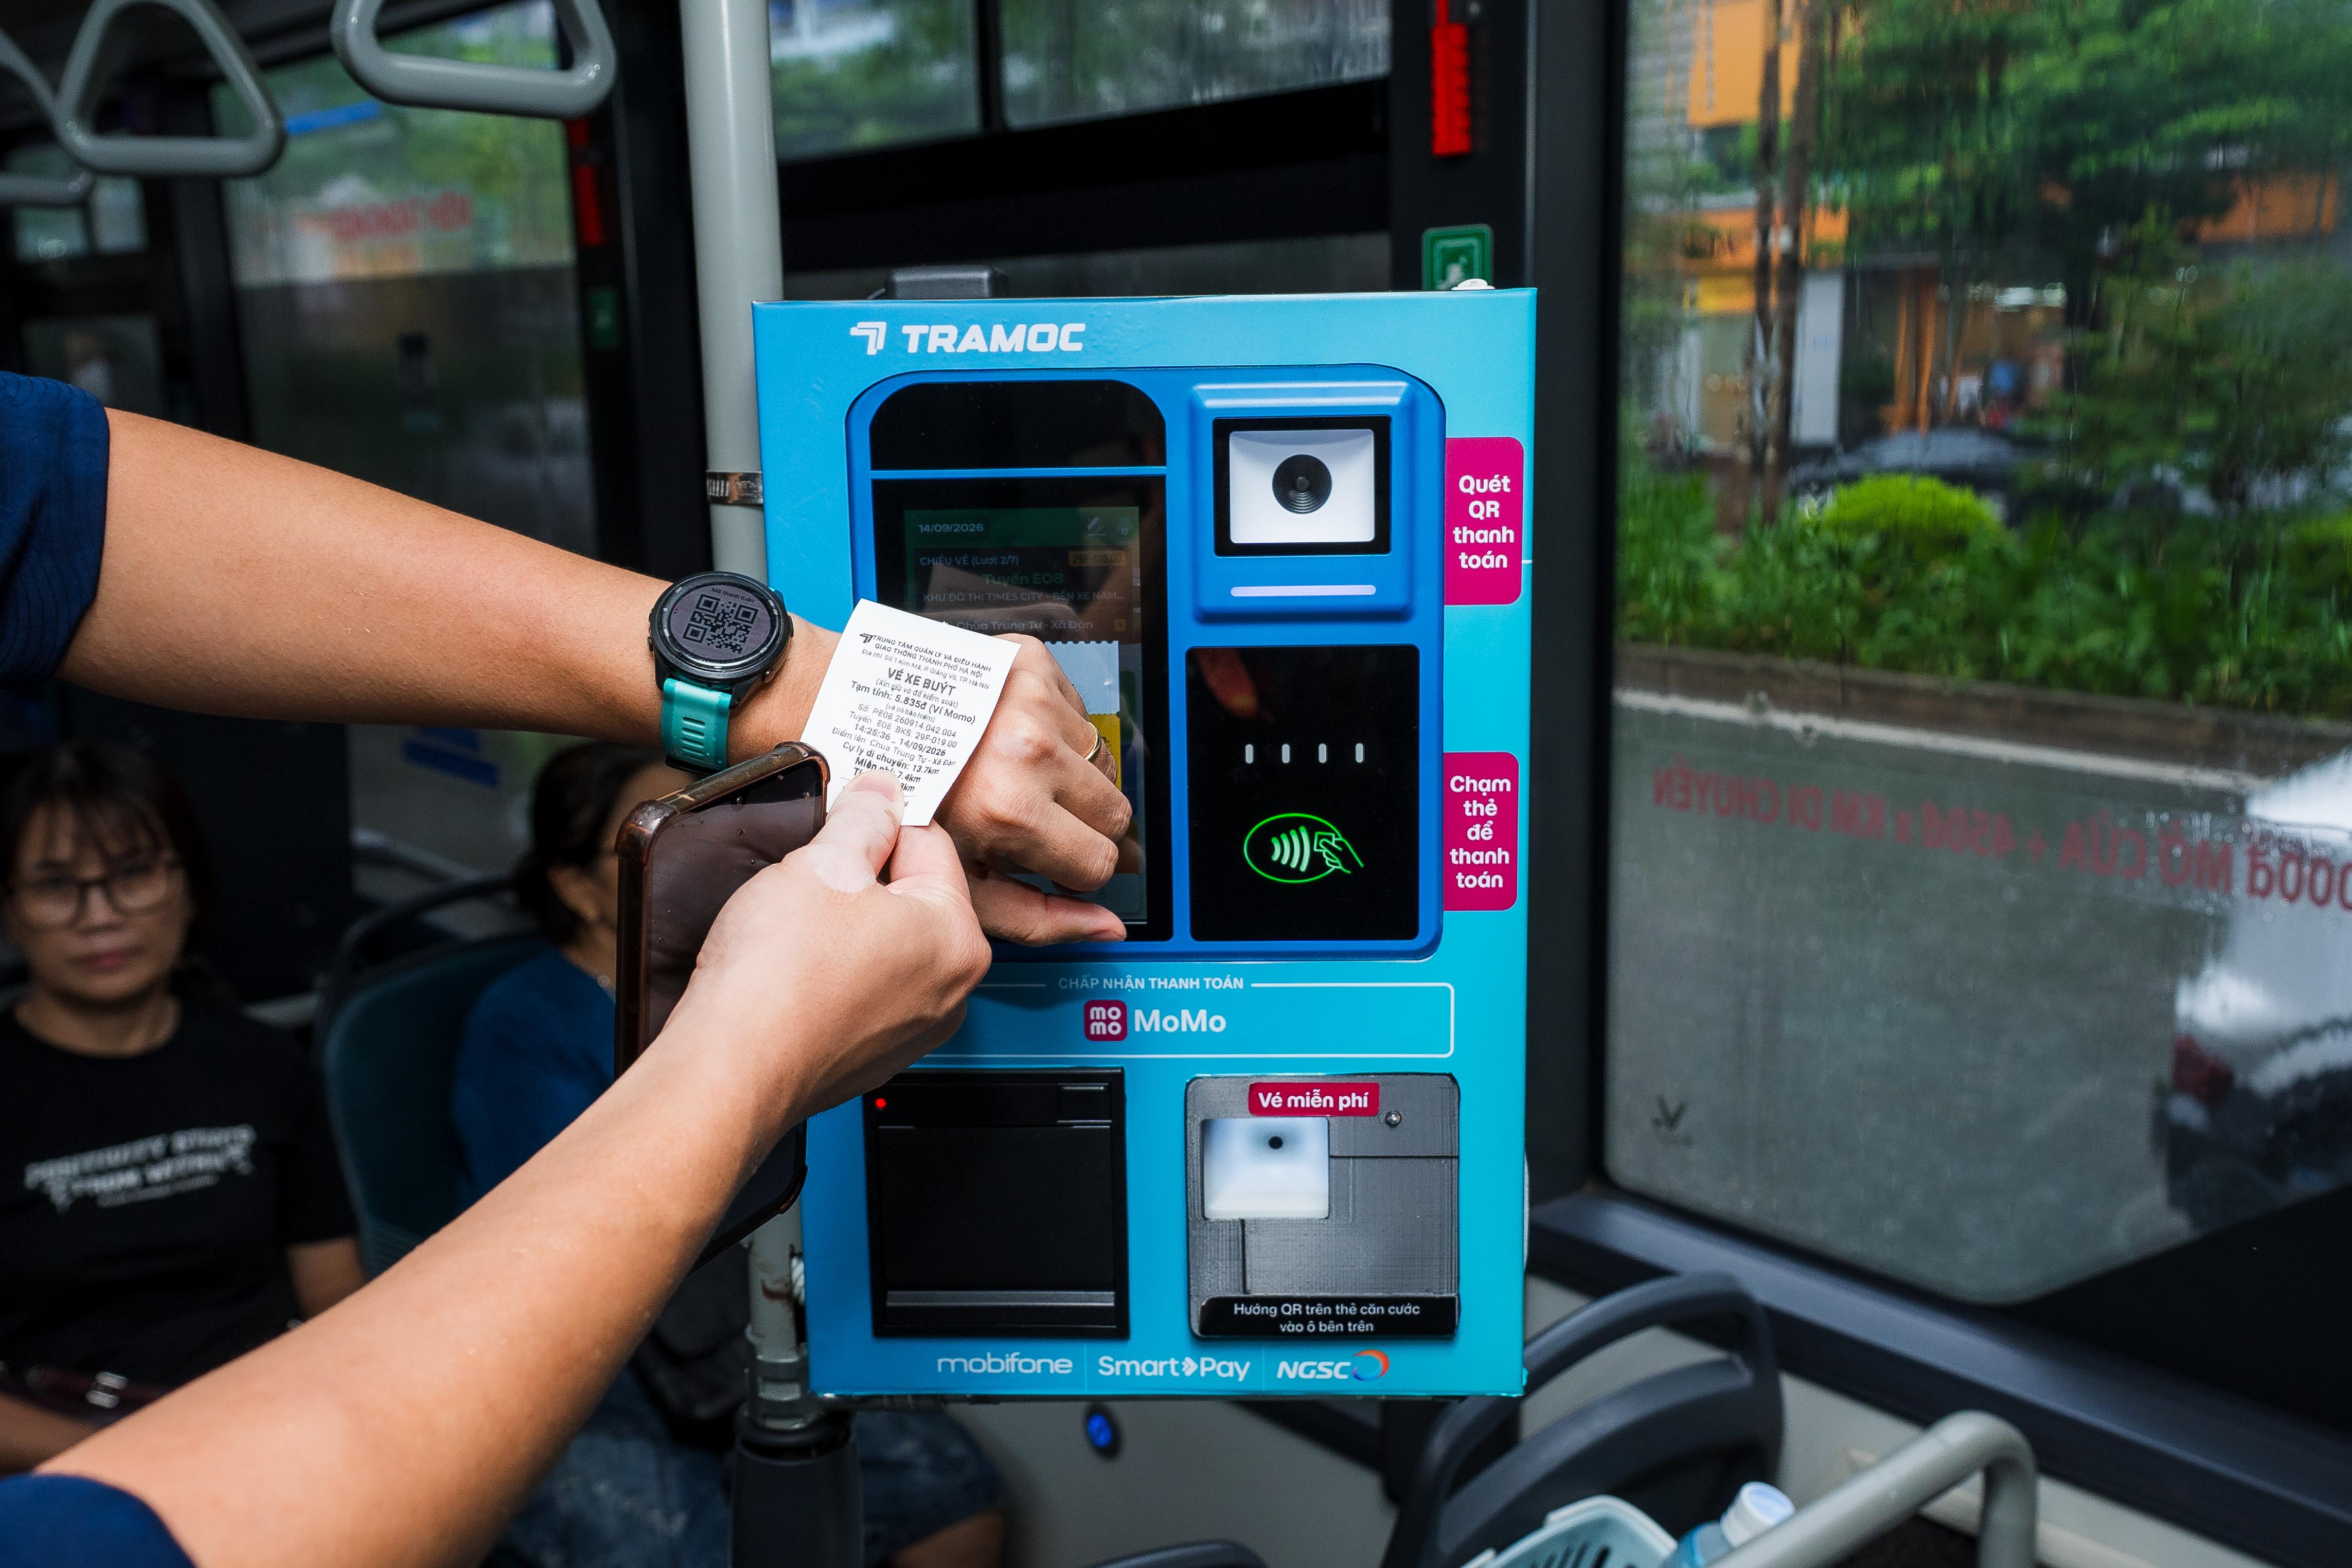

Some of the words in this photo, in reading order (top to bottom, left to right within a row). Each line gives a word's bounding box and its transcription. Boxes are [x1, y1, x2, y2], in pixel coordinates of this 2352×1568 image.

[902, 323, 1085, 353] TRAMOC
[1459, 474, 1510, 495] Quét
[1469, 501, 1499, 520] QR
[918, 523, 984, 532] 14/09/2026
[1453, 526, 1514, 543] thanh
[1001, 554, 1019, 566] 2/7)
[1459, 550, 1507, 568] toán
[982, 571, 1028, 586] Tuyến
[723, 591, 740, 599] thanh
[924, 593, 946, 601] KHU
[987, 592, 1018, 601] TIMES
[1021, 592, 1043, 600] CITY
[1077, 592, 1090, 600] XE
[991, 621, 1025, 631] Trung
[873, 635, 896, 645] TRUNG
[875, 644, 892, 652] GIAO
[894, 648, 917, 659] THÔNG
[876, 678, 889, 688] (Xin
[888, 667, 904, 681] VÉ
[905, 672, 922, 686] XE
[922, 678, 956, 696] BUÝT
[851, 680, 870, 693] Tạm
[872, 687, 893, 700] tính:
[895, 694, 927, 709] 5.835đ
[929, 704, 943, 714] (Ví
[944, 708, 975, 725] Momo)
[877, 720, 892, 730] E08
[894, 746, 915, 761] Trung
[900, 738, 946, 756] 14/09/2026
[843, 741, 856, 753] Cự
[857, 745, 864, 756] ly
[866, 749, 875, 758] di
[913, 764, 939, 775] 13.7km
[897, 771, 921, 782] 7.4km
[1450, 775, 1511, 796] Chạm
[1463, 798, 1498, 816] thẻ
[1467, 820, 1493, 841] để
[1450, 848, 1509, 864] thanh
[1456, 871, 1503, 888] toán
[1058, 973, 1099, 989] CHẤP
[1103, 974, 1145, 992] NHẬN
[1148, 977, 1200, 989] THANH
[1203, 974, 1244, 989] TOÁN
[1134, 1009, 1226, 1032] MoMo
[1258, 1092, 1283, 1108] Vé
[1287, 1089, 1334, 1108] miễn
[1339, 1092, 1369, 1111] phí
[1234, 1303, 1277, 1317] Hướng
[1280, 1303, 1303, 1316] QR
[1306, 1303, 1333, 1315] trên
[1336, 1303, 1357, 1315] thẻ
[1361, 1304, 1384, 1315] căn
[1388, 1302, 1421, 1315] cước
[1280, 1321, 1304, 1332] vào
[1307, 1321, 1316, 1332] ô
[1320, 1321, 1344, 1332] bên
[1348, 1321, 1374, 1332] trên
[937, 1352, 1073, 1375] mobifone
[1277, 1361, 1351, 1379] NGSC
